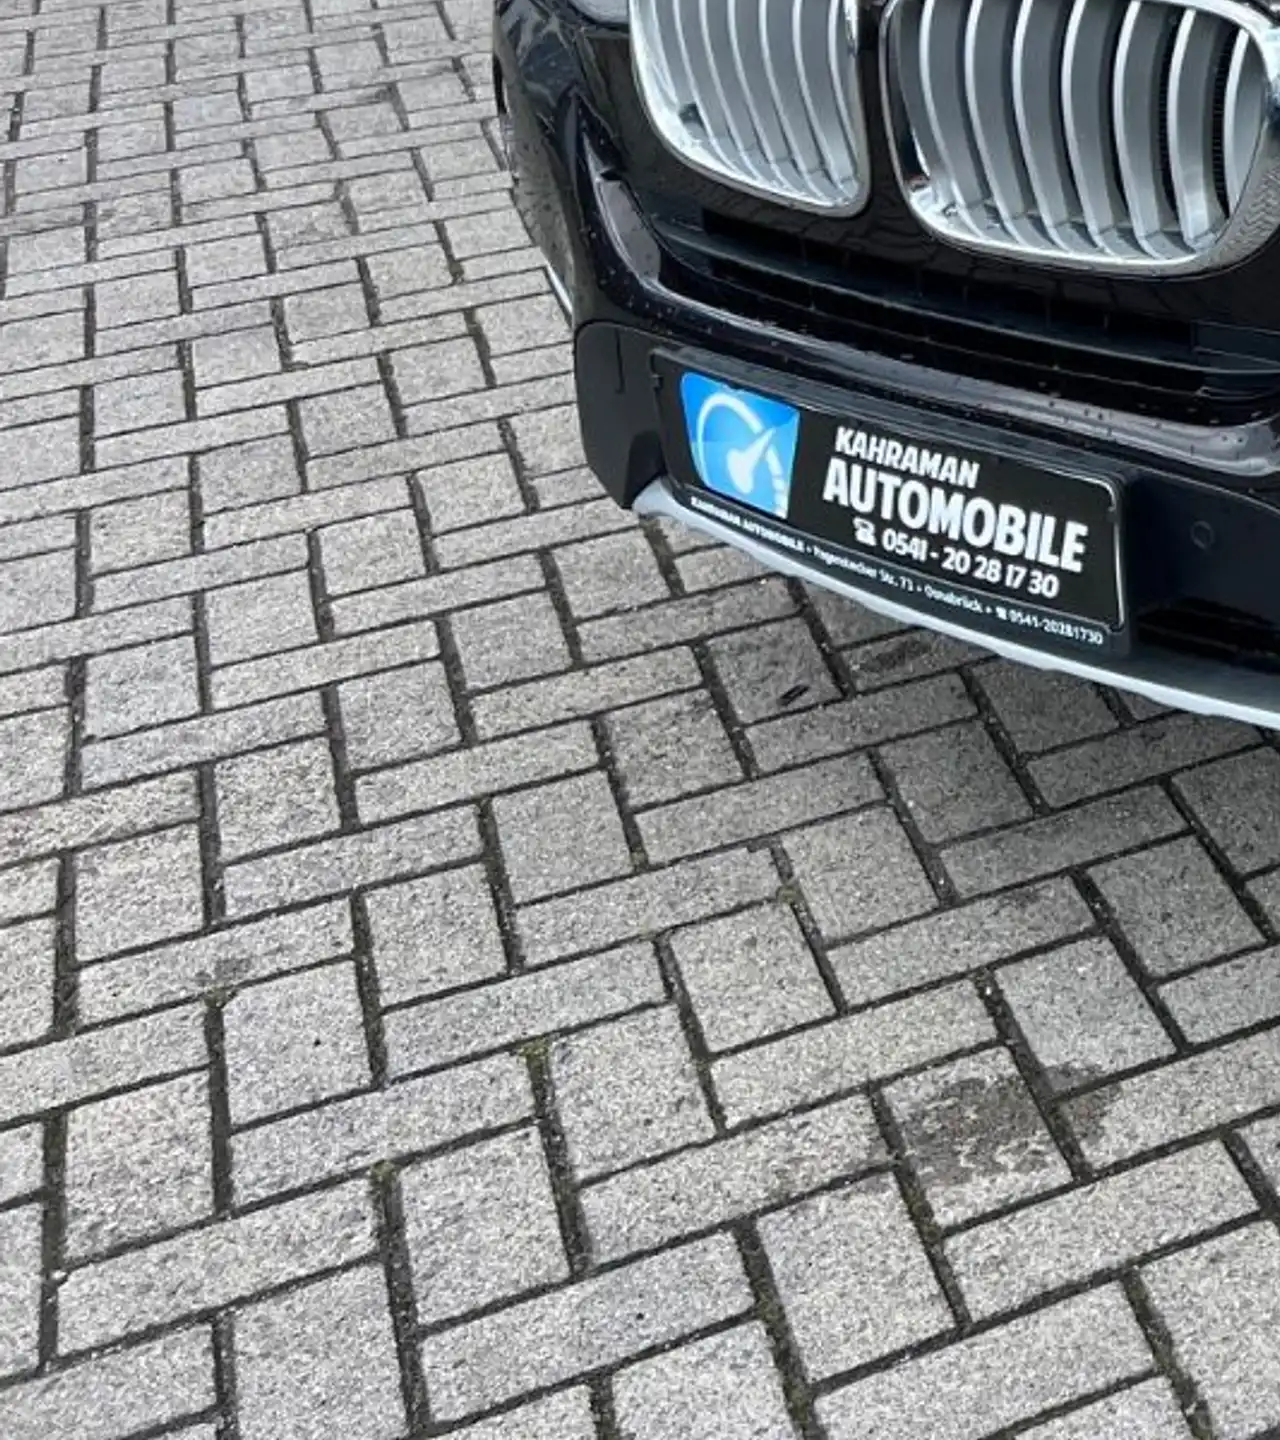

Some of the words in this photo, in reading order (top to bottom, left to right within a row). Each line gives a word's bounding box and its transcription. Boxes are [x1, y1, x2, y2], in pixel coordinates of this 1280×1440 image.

[835, 426, 980, 489] KAHRAMAN
[823, 457, 1089, 573] AUTOMOBILE
[881, 528, 929, 562] 0541
[941, 547, 971, 575] 20
[972, 555, 1002, 583] 28
[1005, 564, 1027, 589] 17
[1028, 571, 1060, 599] 30
